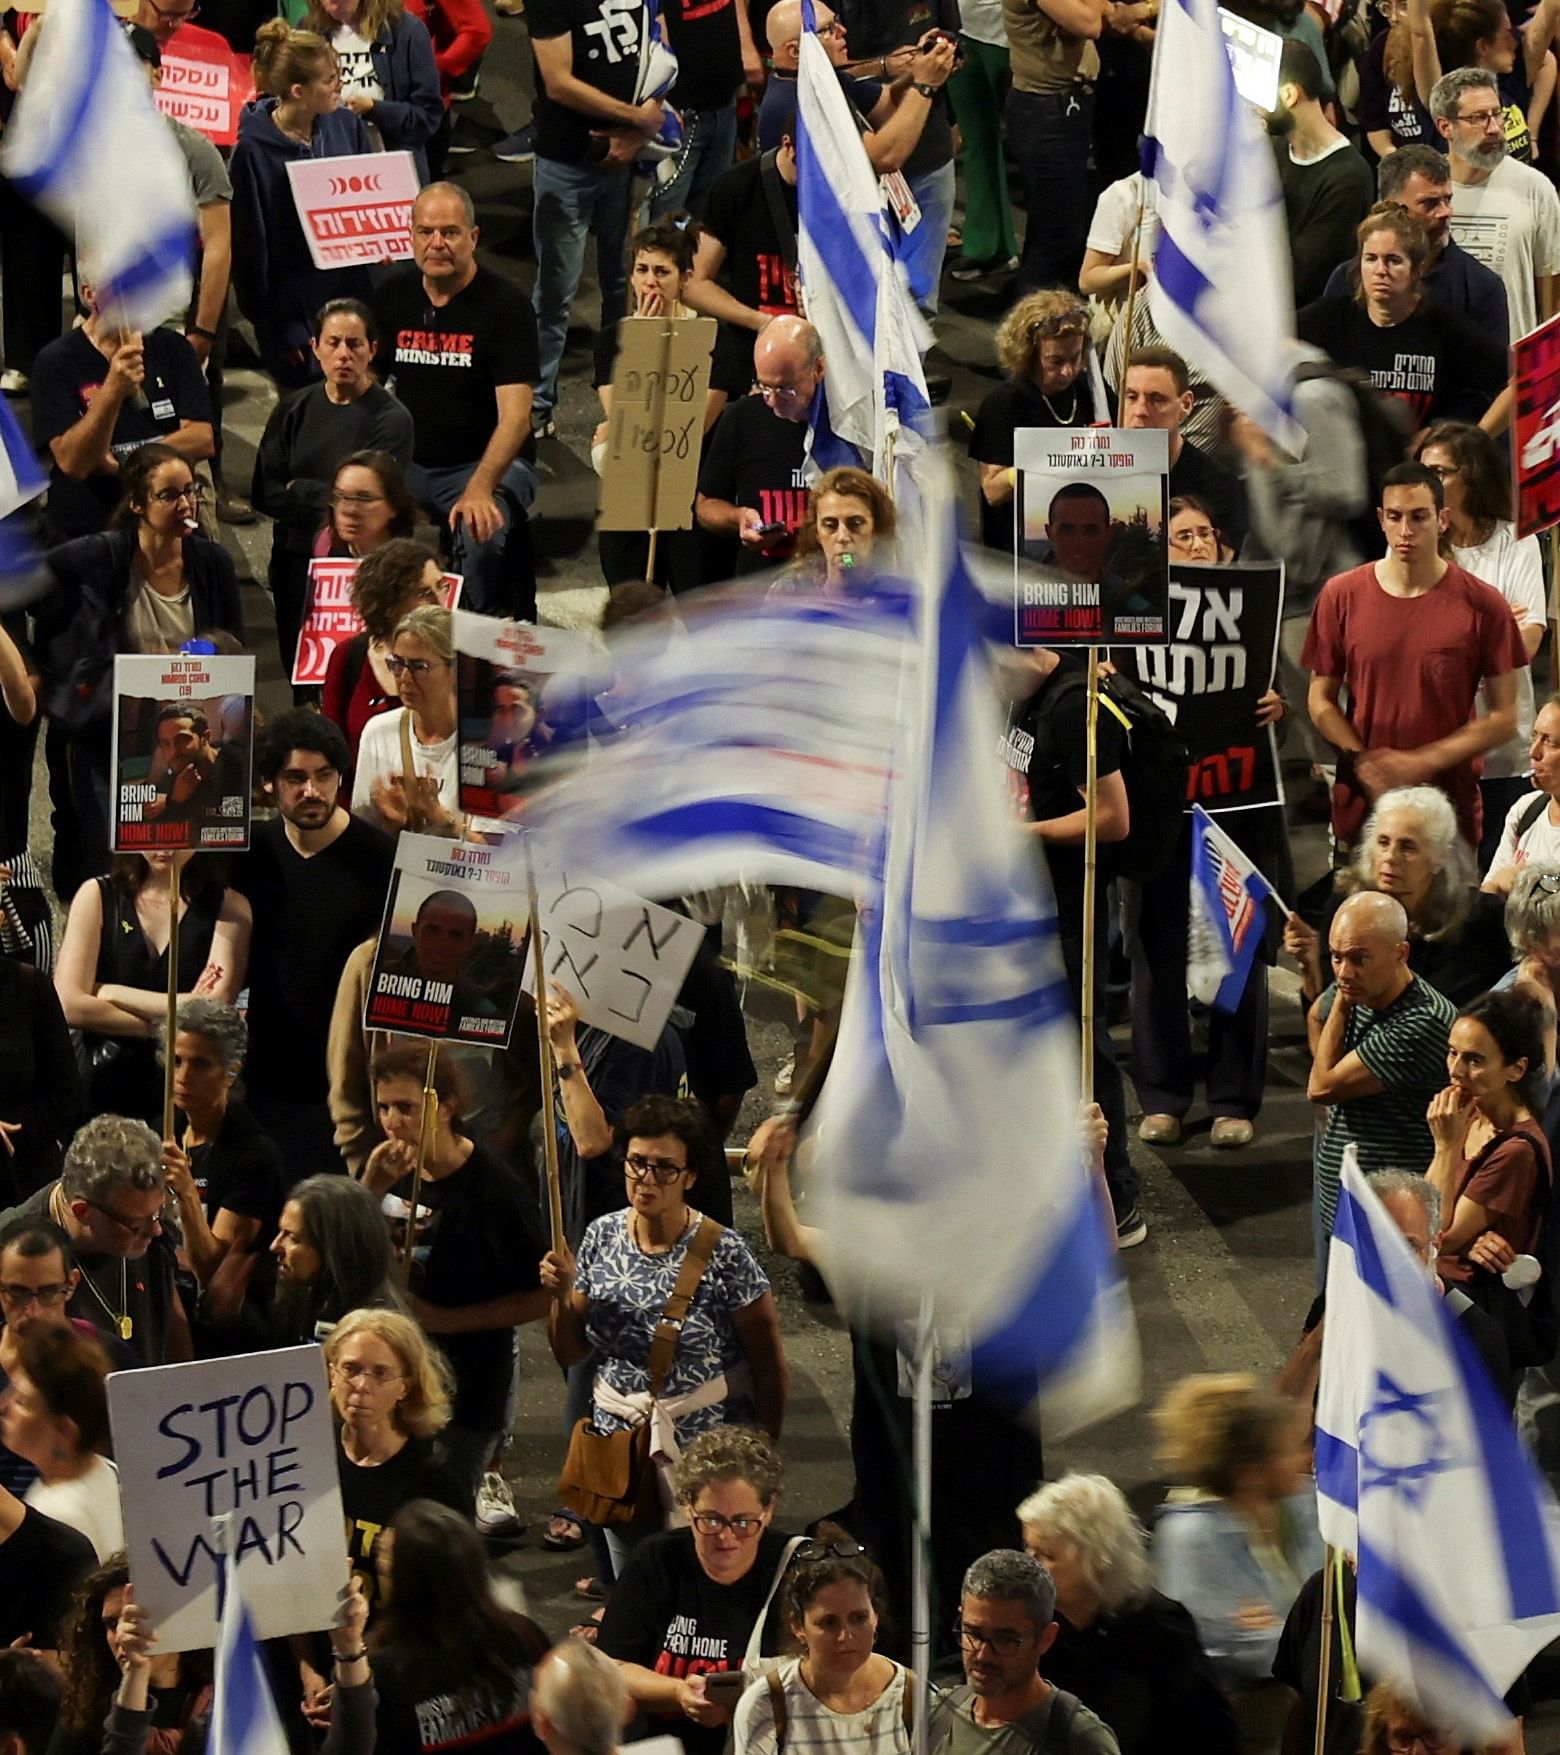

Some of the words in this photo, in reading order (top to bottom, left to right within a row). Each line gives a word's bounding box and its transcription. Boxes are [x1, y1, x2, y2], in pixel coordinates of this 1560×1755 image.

[320, 240, 384, 261] הביתה
[396, 330, 474, 353] CRIME
[395, 348, 472, 367] MINISTER
[1394, 353, 1435, 373] מחזירים
[1370, 370, 1406, 389] הביתה
[1407, 372, 1434, 391] אותם
[1071, 437, 1085, 450] כהן
[1047, 453, 1088, 468] באוקטובר
[1108, 453, 1134, 468] הופקר
[1024, 583, 1068, 605] BRING
[1072, 583, 1100, 605] HIM
[120, 784, 157, 803] BRING
[120, 803, 143, 822] HIM
[377, 972, 422, 999] BRING
[424, 980, 454, 1004] HIM
[157, 1382, 314, 1479] STOP
[184, 1447, 305, 1517] THE
[151, 1501, 305, 1588] WAR
[691, 1637, 728, 1659] HOME
